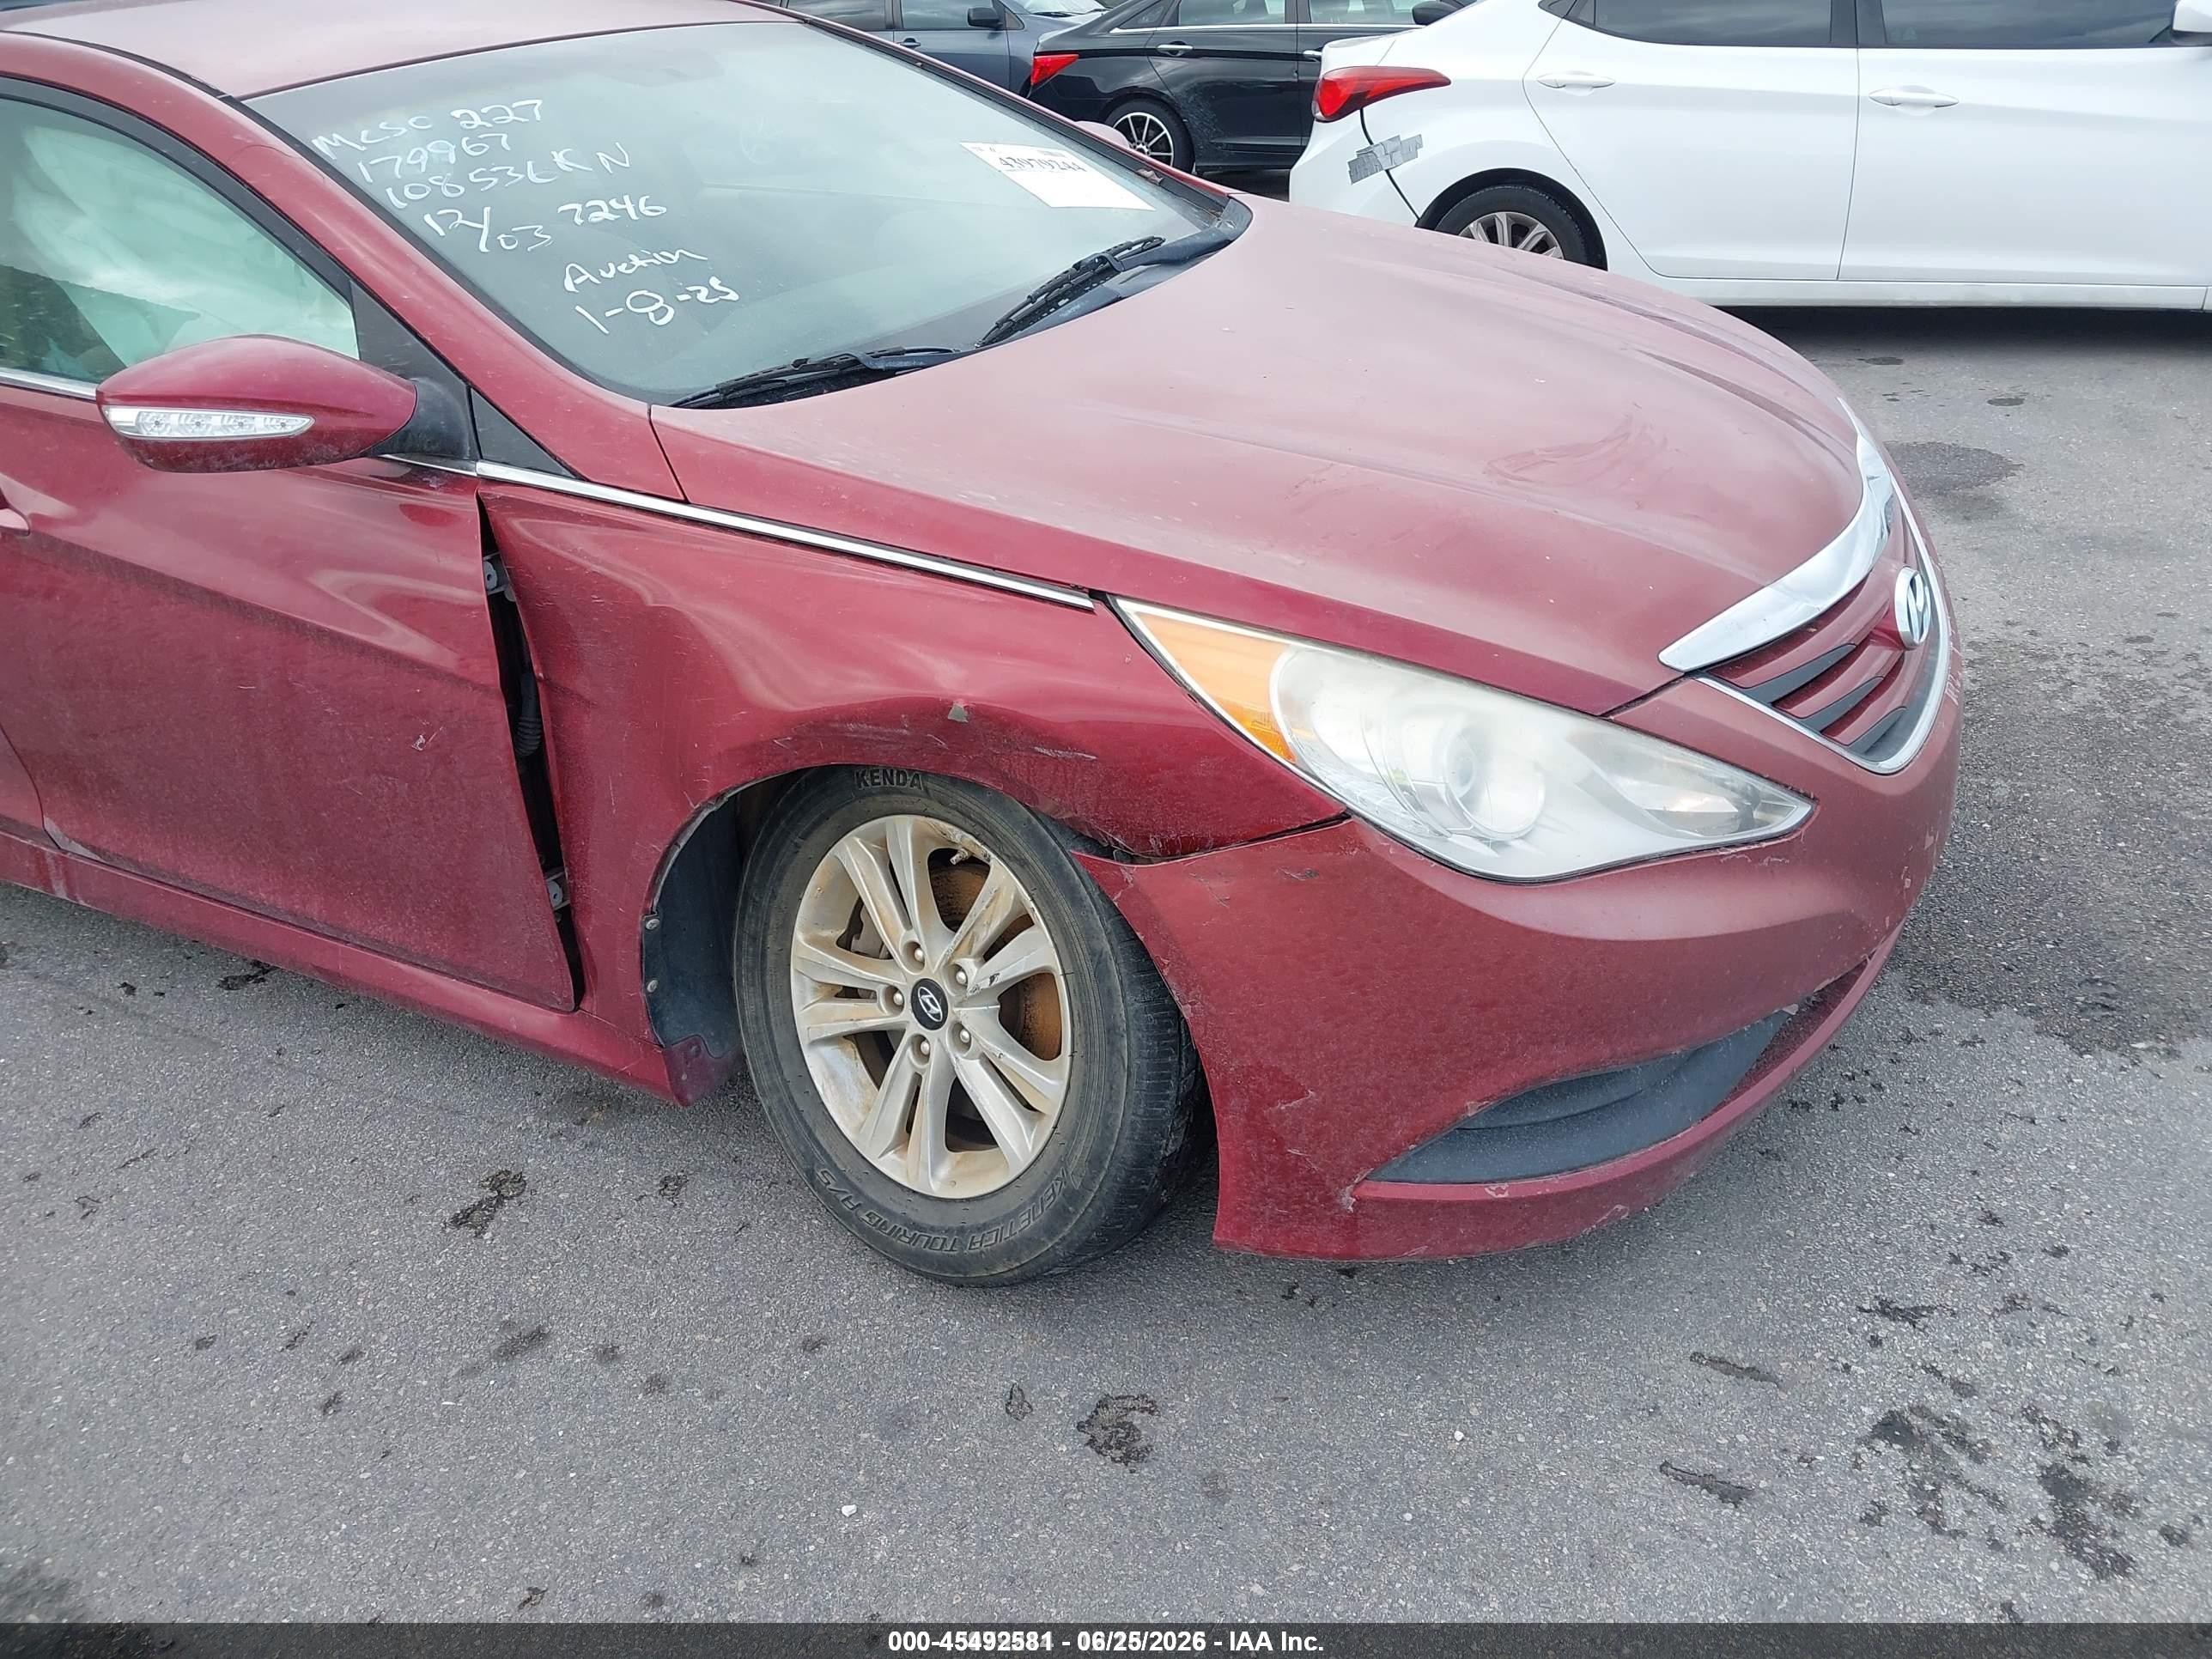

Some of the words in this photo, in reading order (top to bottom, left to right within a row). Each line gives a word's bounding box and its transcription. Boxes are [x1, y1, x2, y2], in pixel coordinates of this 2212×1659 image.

[450, 99, 544, 129] 227
[557, 194, 667, 225] 7246
[854, 767, 925, 792] KENDA
[815, 1167, 862, 1212] A/S
